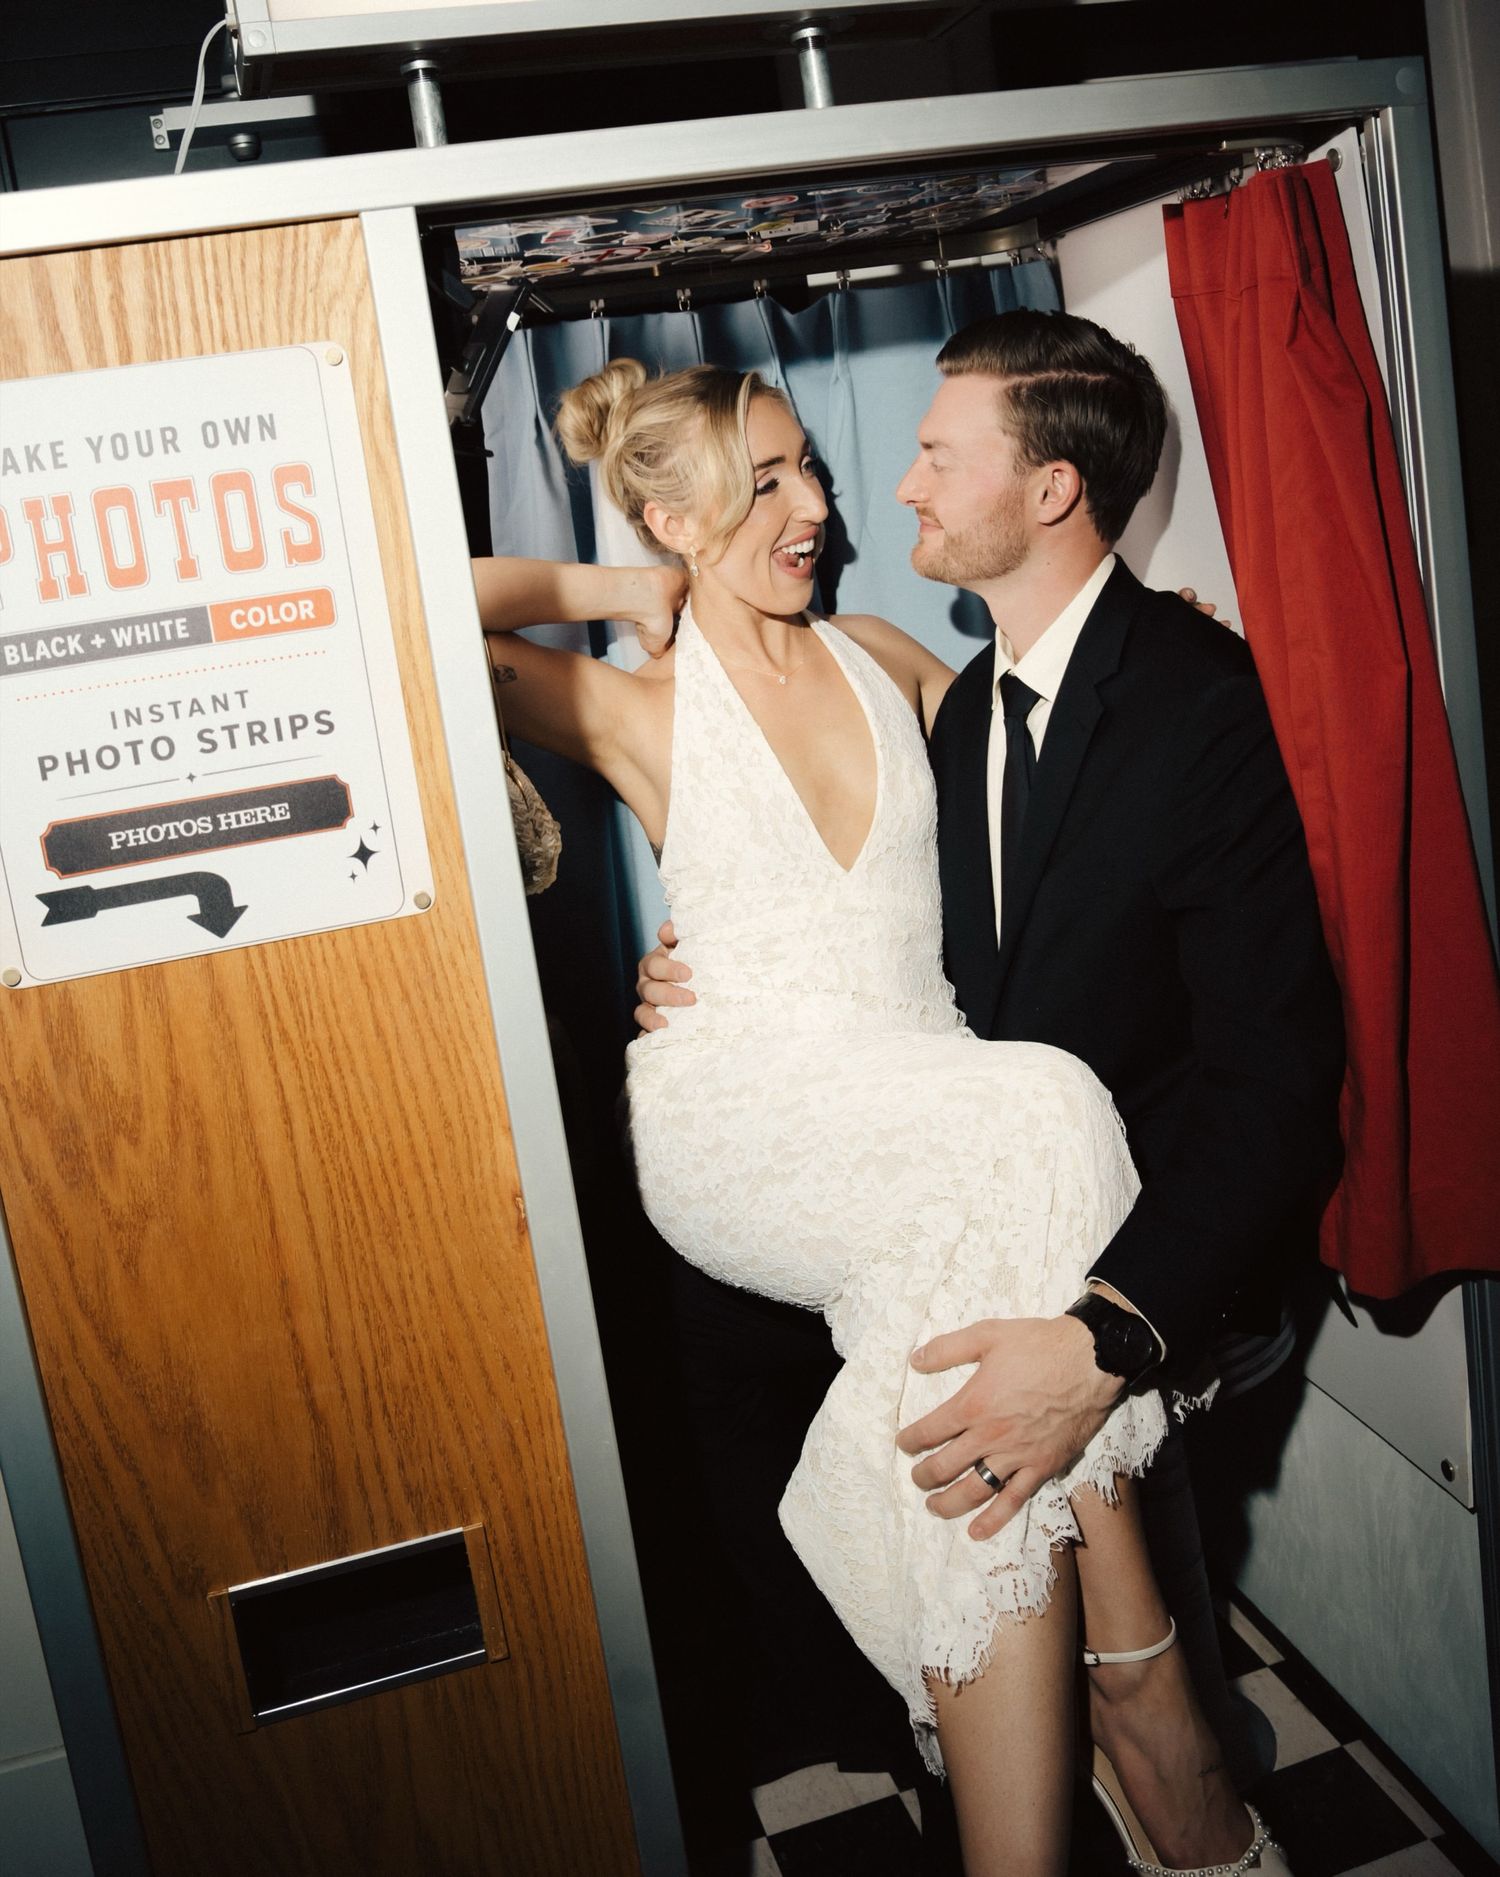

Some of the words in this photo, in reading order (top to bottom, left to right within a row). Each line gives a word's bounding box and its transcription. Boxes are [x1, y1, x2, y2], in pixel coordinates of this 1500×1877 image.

[1, 439, 69, 477] AKE
[84, 424, 182, 464] YOUR
[201, 412, 278, 449] OWN
[0, 461, 325, 609] HOTOS
[230, 599, 315, 631] COLOR
[4, 632, 84, 666] BLACK
[90, 634, 107, 649] +
[111, 618, 190, 648] WHITE
[110, 689, 250, 730] INSTANT
[37, 735, 176, 782] PHOTO
[197, 709, 336, 754] STRIPS
[108, 816, 213, 850] PHOTOS
[217, 802, 291, 830] HERE
